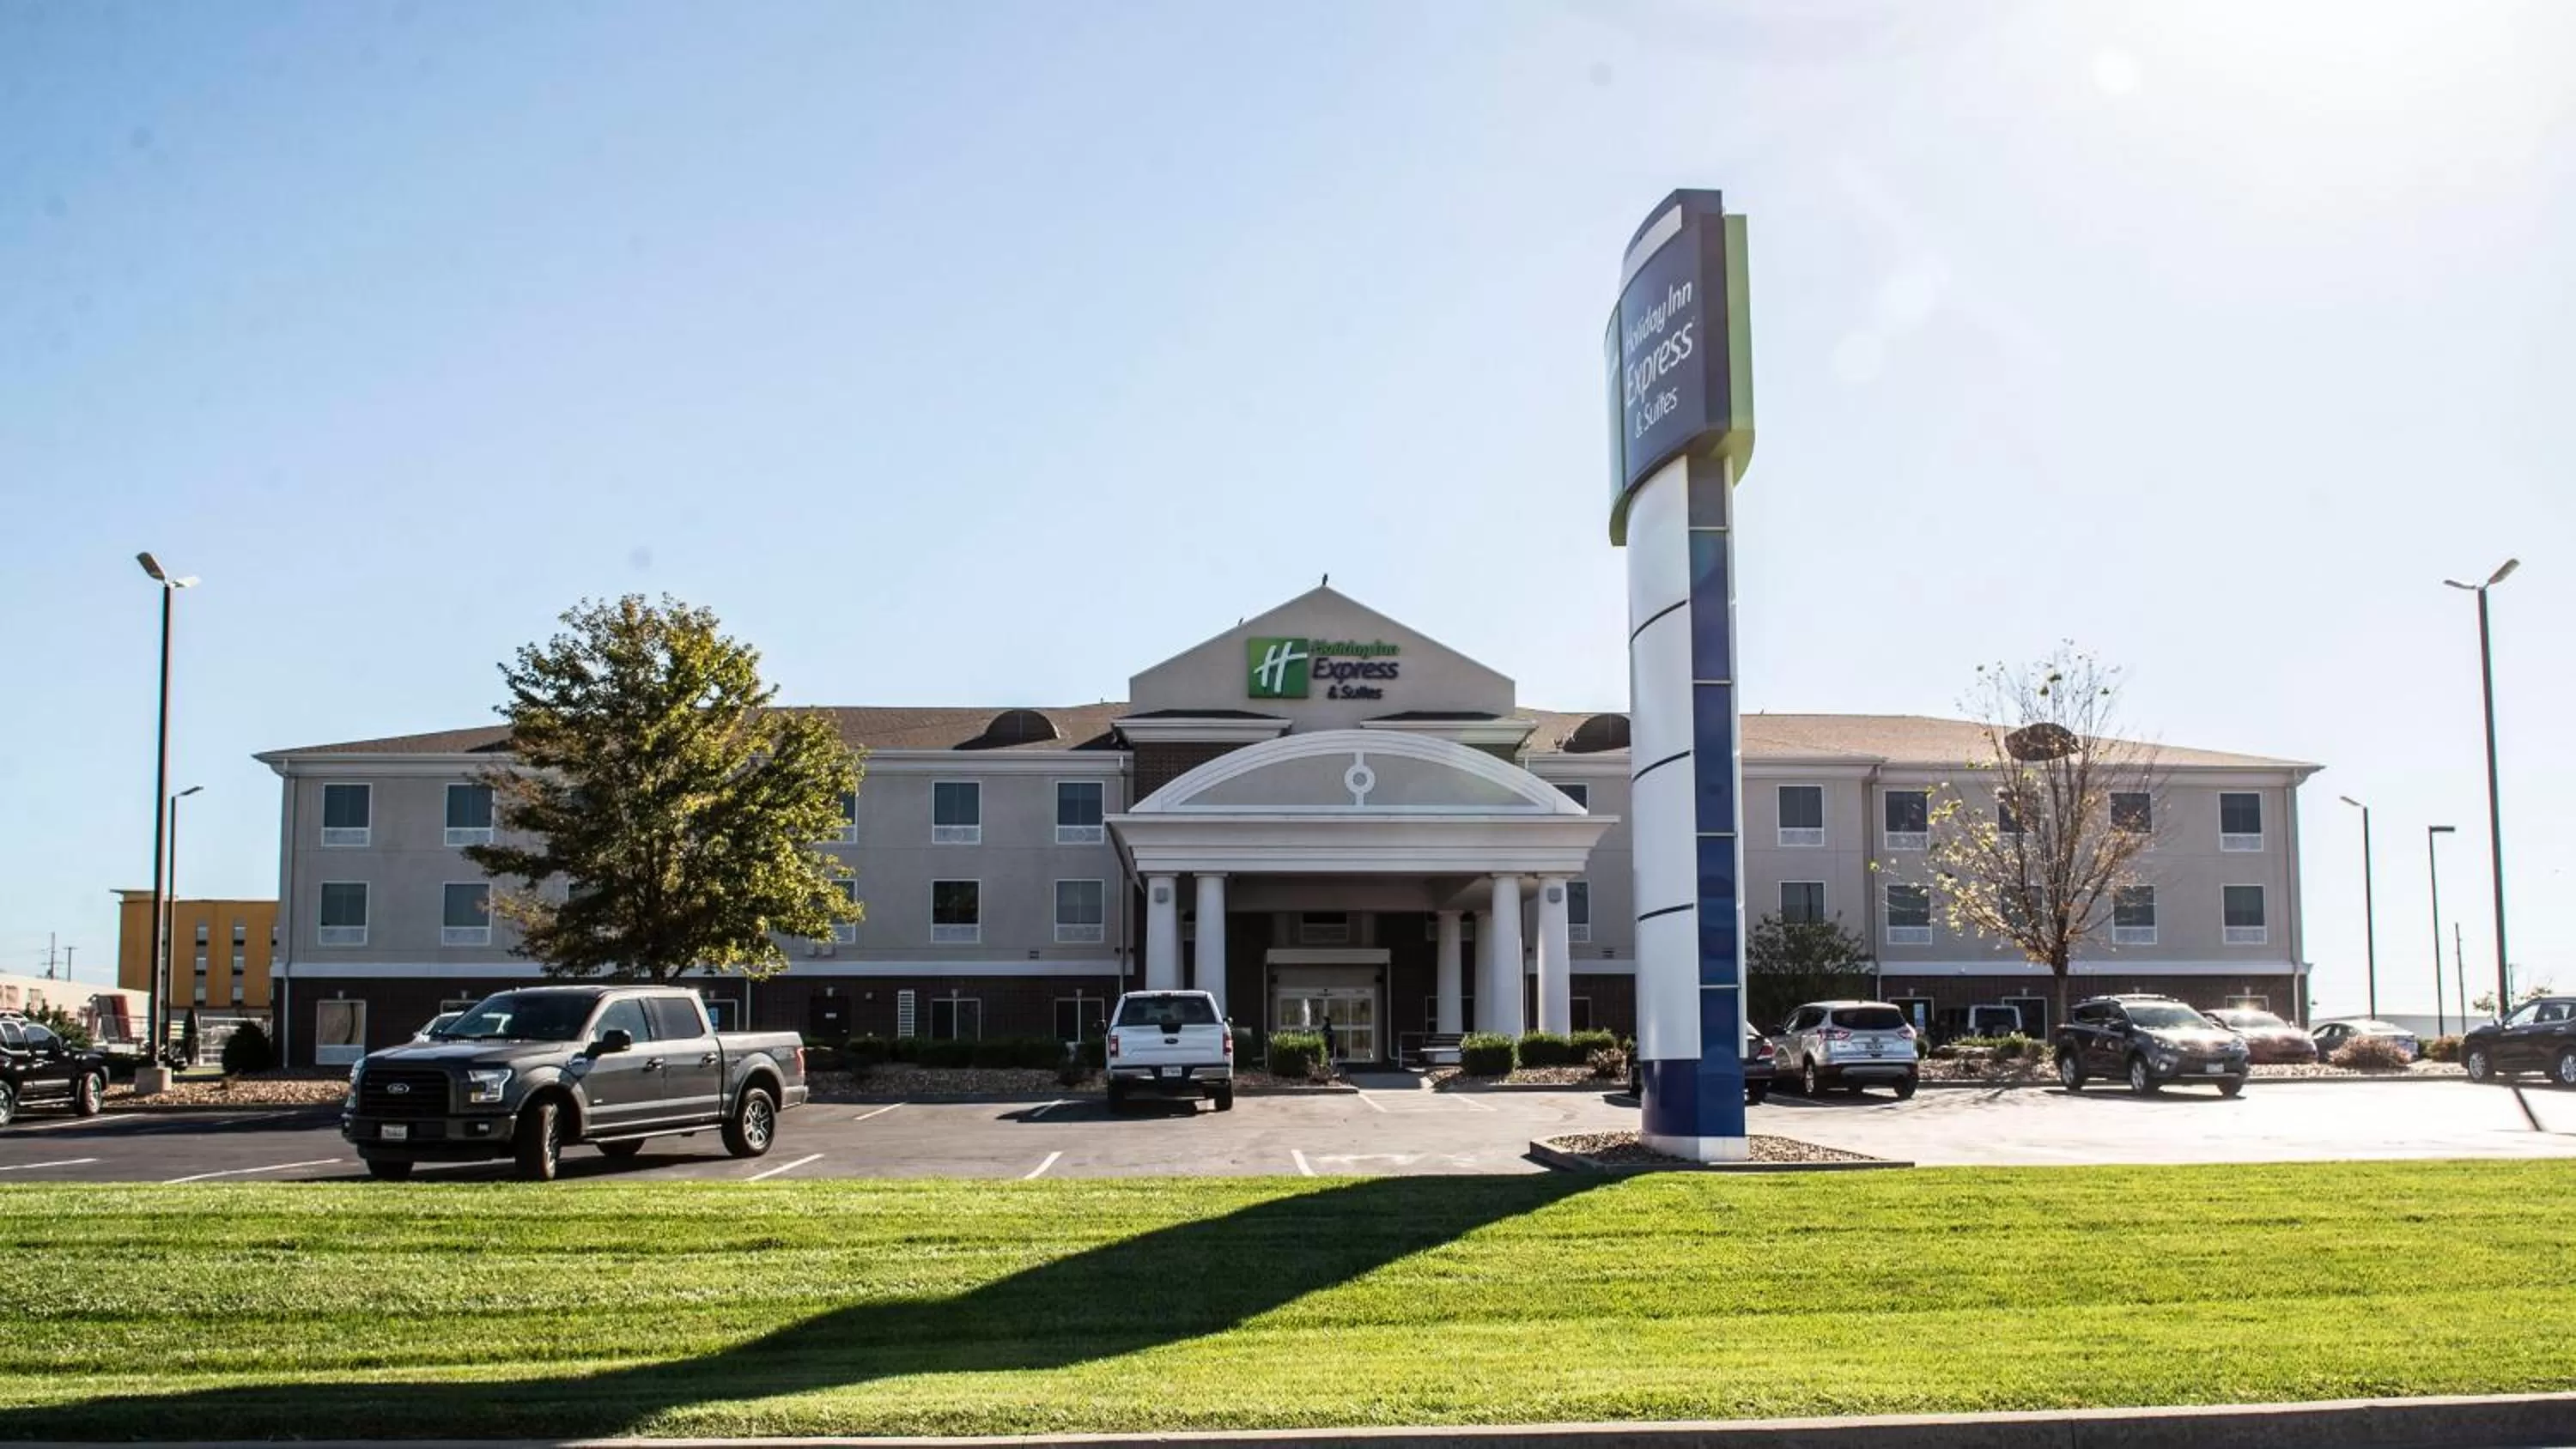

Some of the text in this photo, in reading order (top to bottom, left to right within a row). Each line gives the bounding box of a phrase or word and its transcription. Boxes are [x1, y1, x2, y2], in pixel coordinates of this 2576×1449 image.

[1625, 282, 1692, 358] Holiday Inn
[1627, 322, 1692, 408] Express
[1635, 387, 1677, 439] & Suites
[1312, 657, 1399, 684] Express
[1340, 685, 1383, 700] Suites
